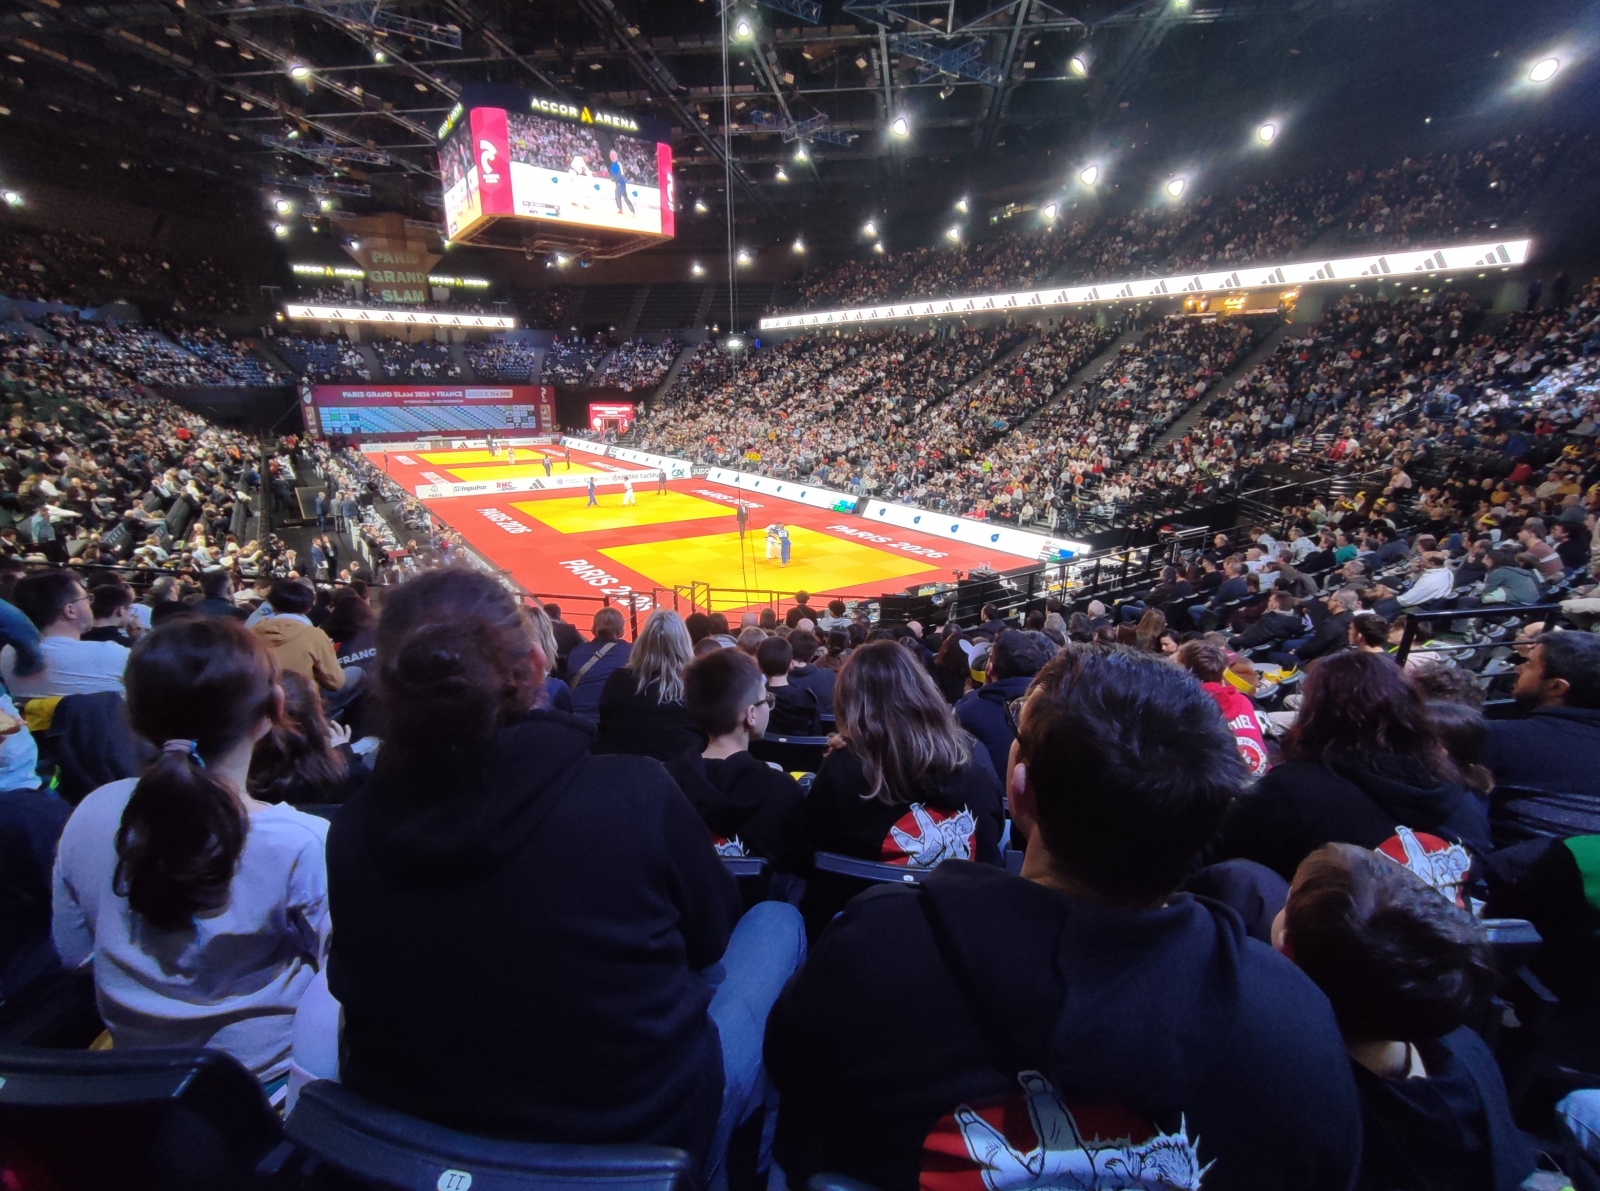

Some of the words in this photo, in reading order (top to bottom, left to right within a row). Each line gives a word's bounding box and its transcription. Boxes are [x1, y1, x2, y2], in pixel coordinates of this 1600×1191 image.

[531, 97, 579, 118] ACCOR
[594, 111, 639, 131] ARENA
[369, 270, 426, 284] GRAND
[381, 289, 425, 302] SLAM
[476, 507, 511, 524] PARIS
[498, 520, 533, 534] 2026
[825, 524, 893, 543] PARIS
[886, 541, 949, 559] 2026
[558, 558, 619, 587] PARIS
[337, 647, 377, 666] FRANC
[1227, 714, 1256, 730] NIEL
